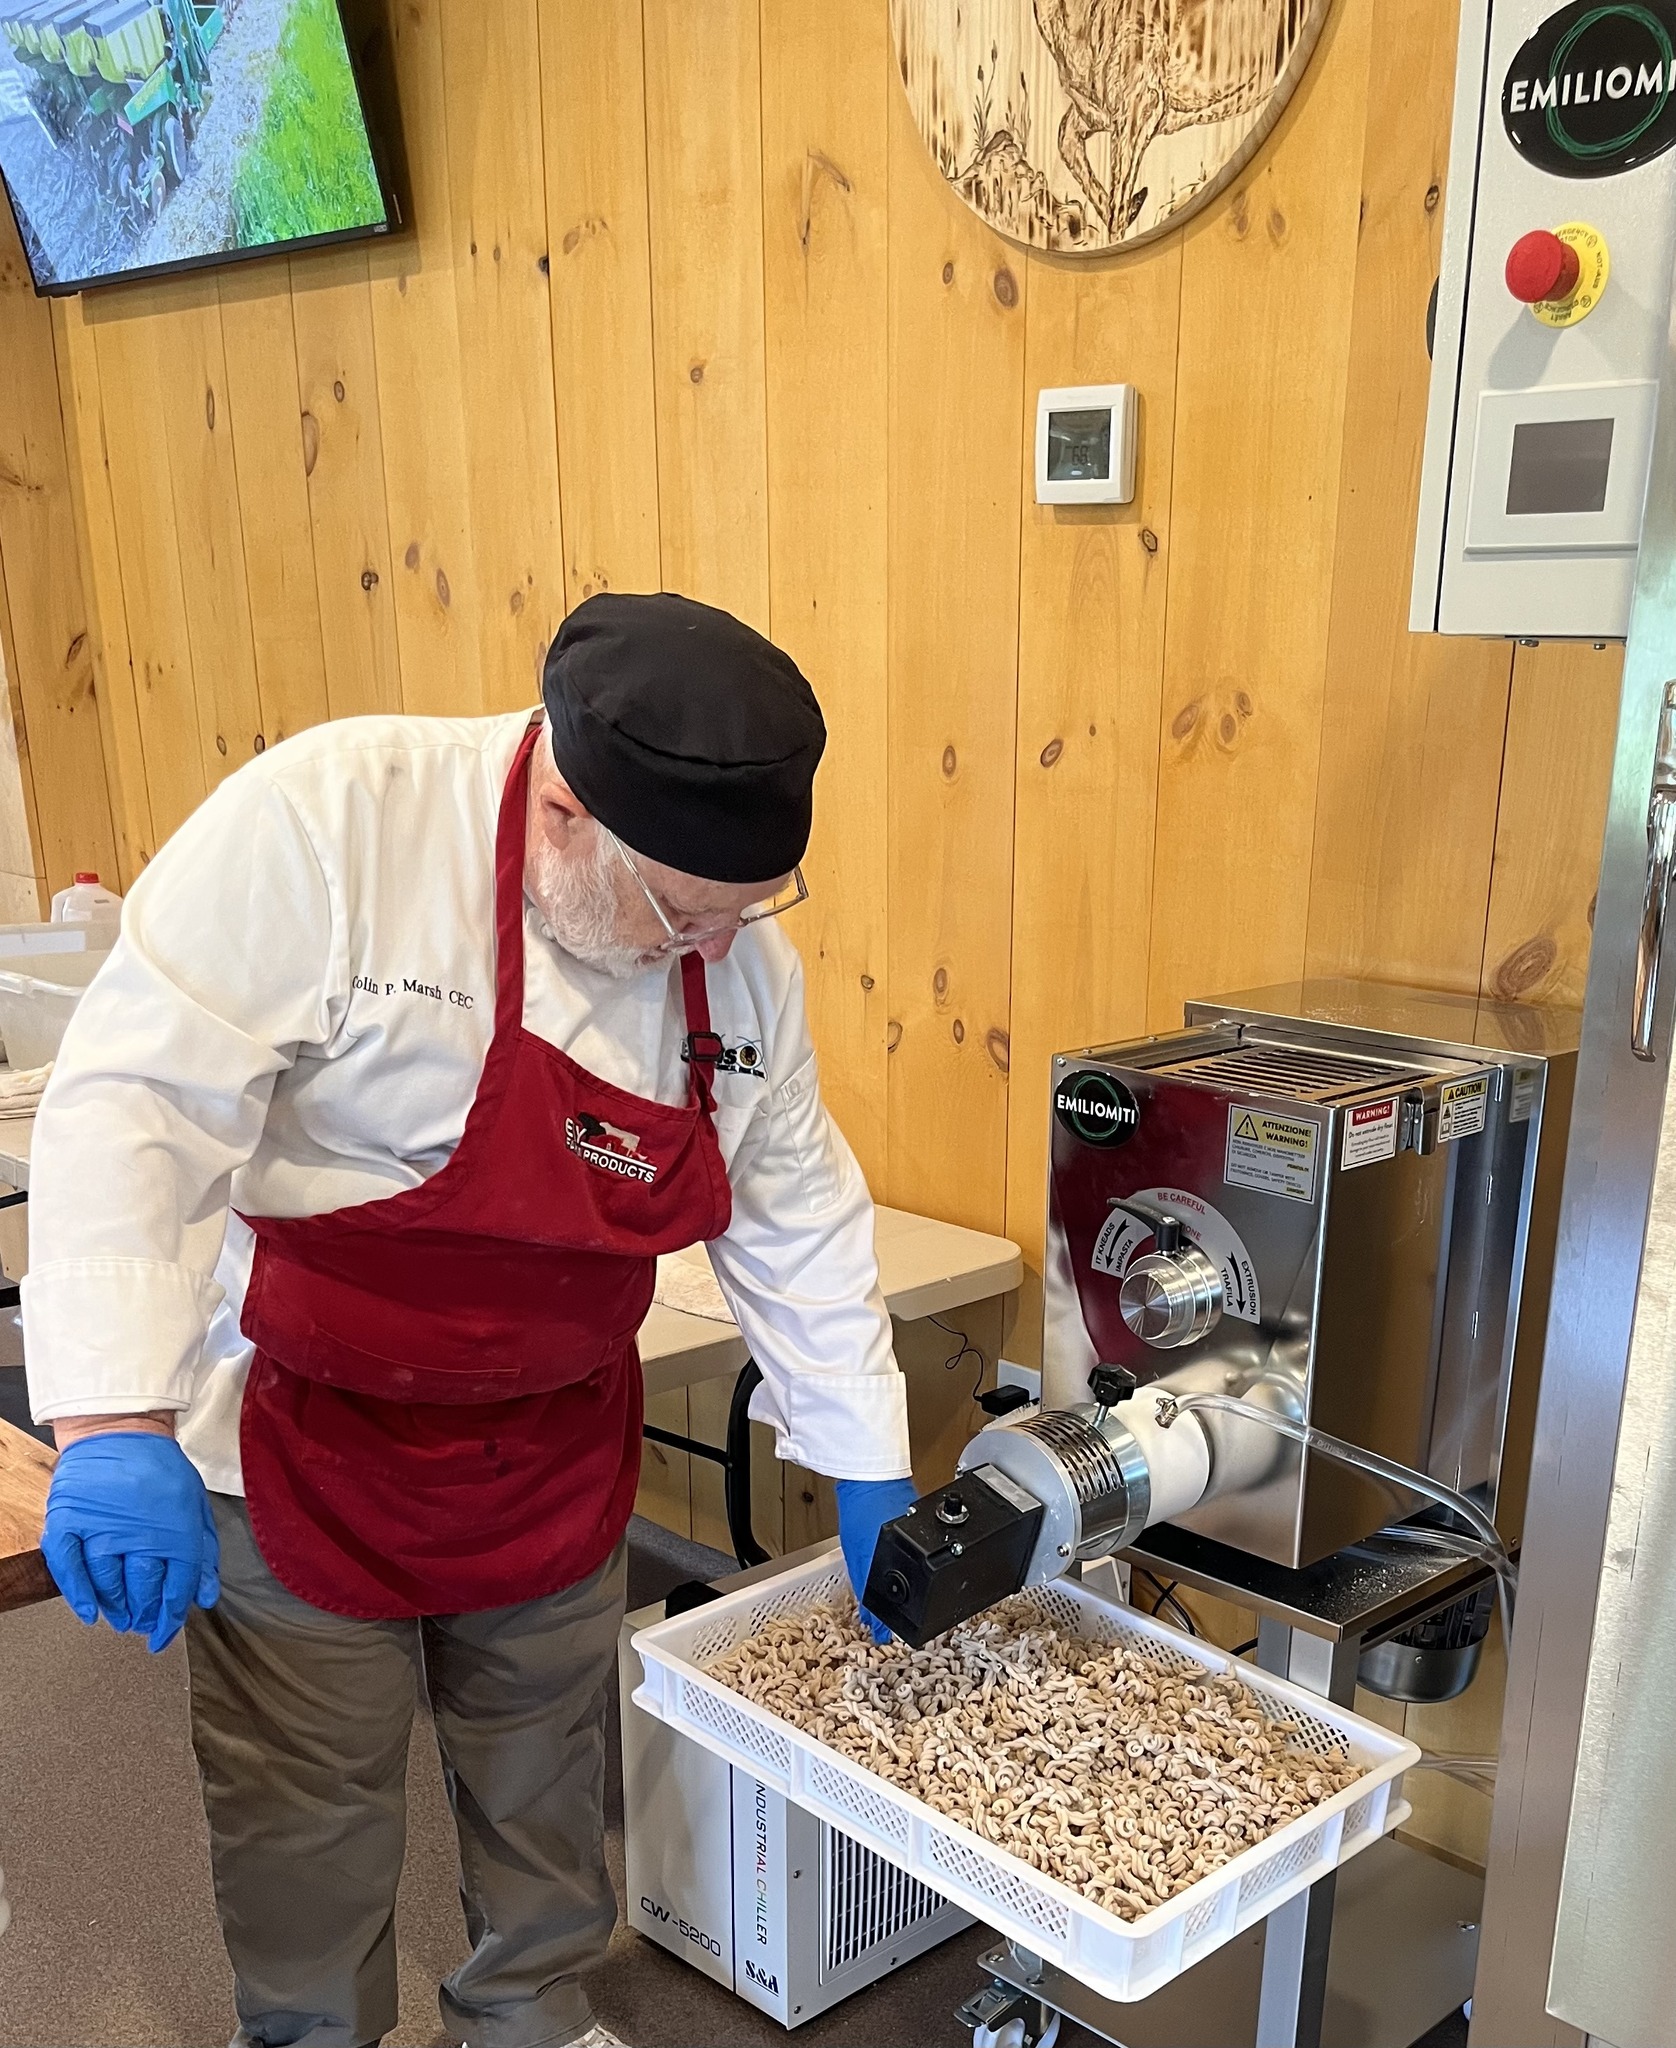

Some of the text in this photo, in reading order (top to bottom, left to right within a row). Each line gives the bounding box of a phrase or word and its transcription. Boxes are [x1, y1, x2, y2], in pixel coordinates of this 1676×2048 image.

[385, 983, 397, 995] P.
[402, 978, 442, 1000] Marsh
[448, 990, 474, 1009] CEC
[1455, 1082, 1483, 1098] CAUTION
[1057, 1094, 1135, 1124] EMILIOMITI
[1355, 1105, 1390, 1121] WARNING!
[1262, 1120, 1312, 1138] ATTENZIONE!
[1265, 1132, 1308, 1148] WARNING!
[583, 1149, 655, 1183] PRODUCTS
[1157, 1192, 1206, 1215] BE CAREFUL
[1095, 1222, 1116, 1265] IT KNEADS
[1115, 1239, 1134, 1273] IMPASTA
[1220, 1267, 1234, 1307] TRAFILA
[1241, 1260, 1257, 1316] EXTRUSION
[755, 1779, 767, 1945] INDUSTRIAL CHILLER
[745, 1959, 779, 1994] S&A
